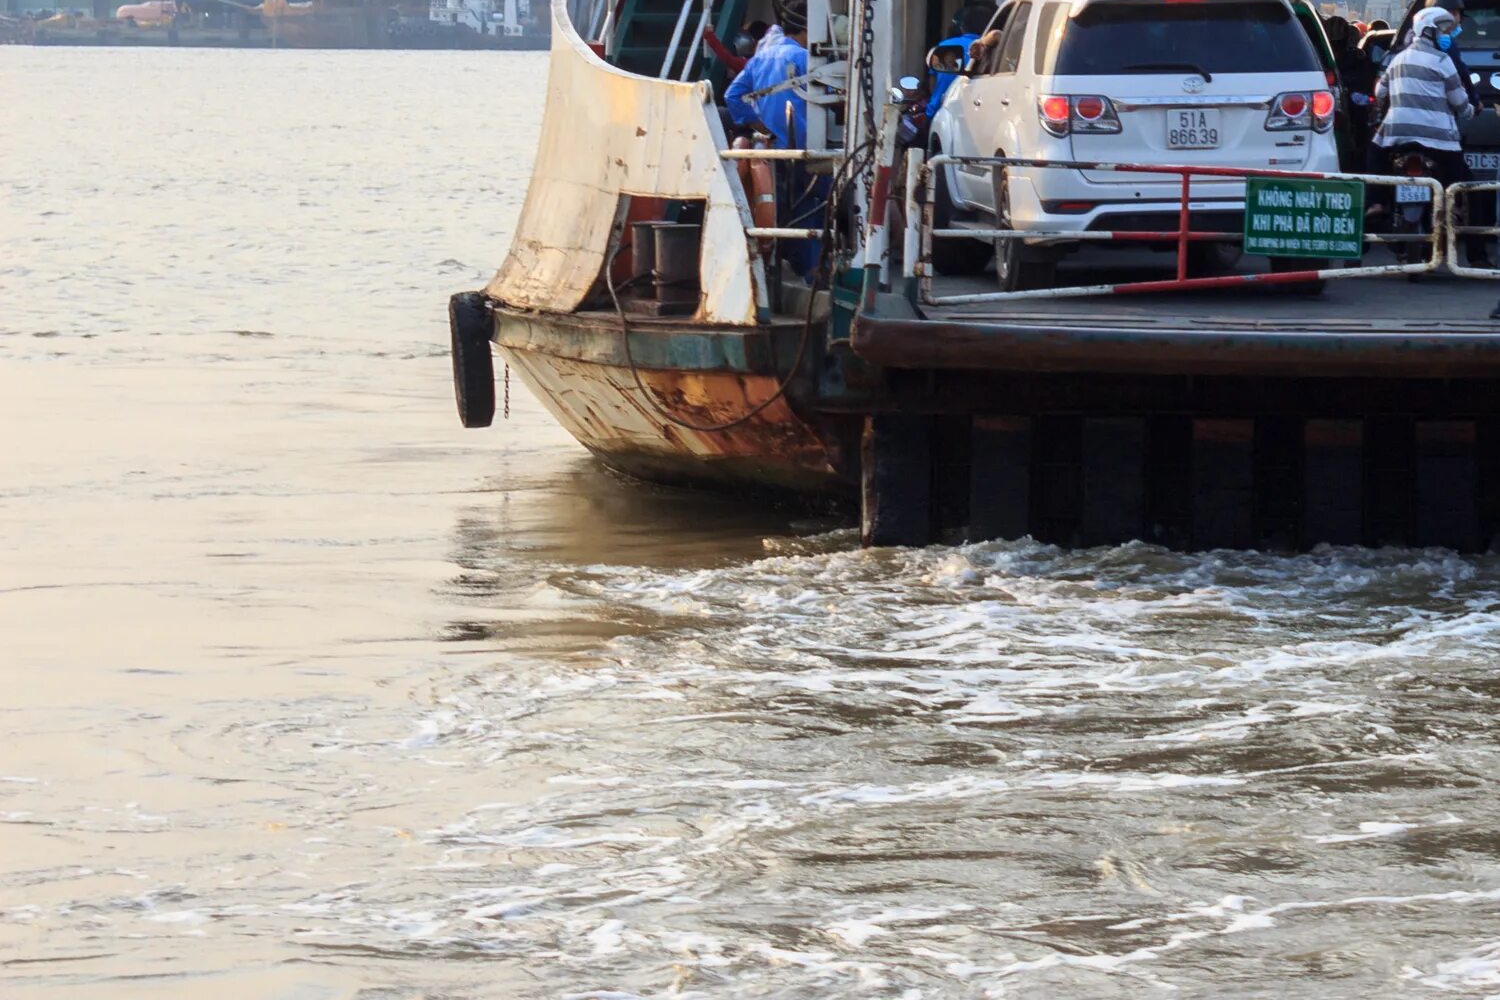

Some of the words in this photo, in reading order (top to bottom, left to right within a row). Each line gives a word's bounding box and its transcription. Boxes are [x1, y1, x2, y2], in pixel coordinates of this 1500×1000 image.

[1180, 112, 1206, 128] 51A
[1170, 129, 1217, 145] 866.39
[1258, 186, 1293, 207] KHÔNG
[1295, 185, 1322, 208] NHẢY
[1325, 192, 1352, 209] THEO
[1253, 214, 1271, 231] KHI
[1273, 210, 1293, 232] PHÀ
[1296, 212, 1311, 233] ĐÃ
[1313, 212, 1331, 234] RỜI
[1333, 212, 1355, 234] BẾN
